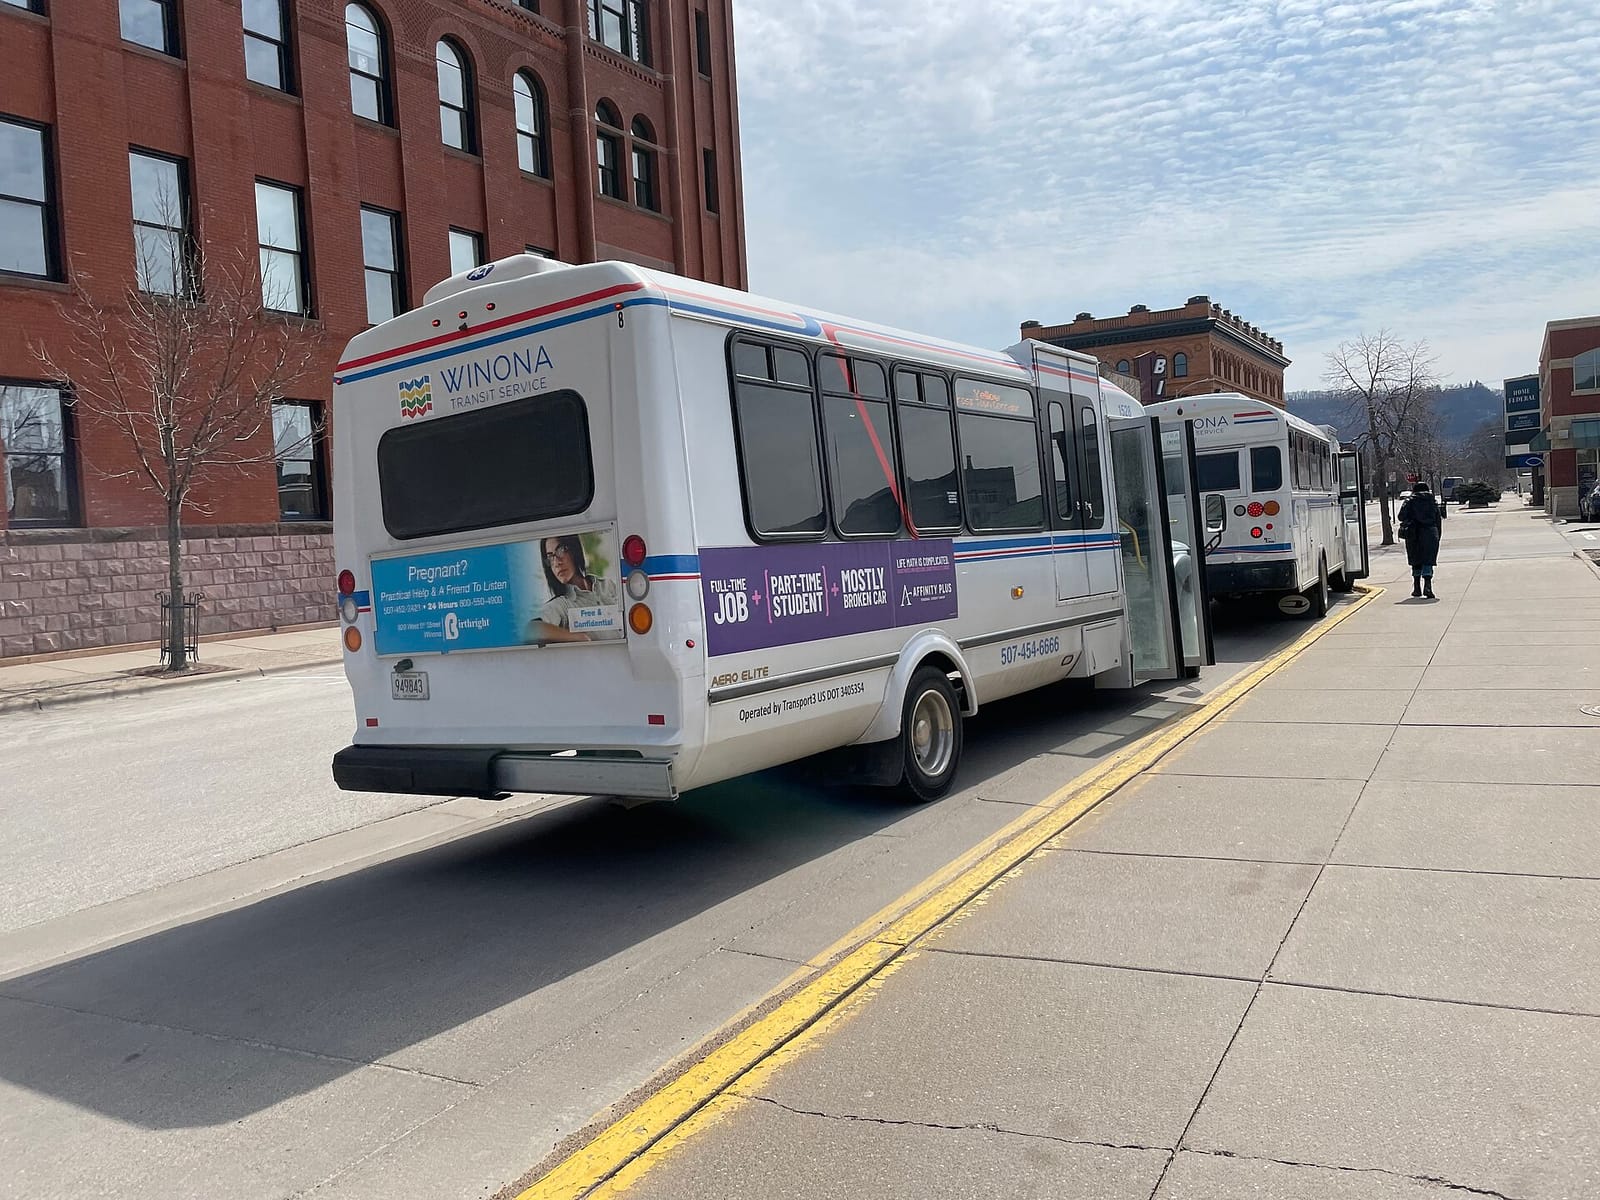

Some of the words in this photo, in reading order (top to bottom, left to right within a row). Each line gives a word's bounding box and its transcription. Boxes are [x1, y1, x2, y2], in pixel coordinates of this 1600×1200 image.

[618, 311, 624, 328] 8
[440, 345, 553, 393] WINONA
[450, 389, 495, 409] TRANSIT
[499, 377, 547, 398] SERVICE
[1508, 394, 1535, 404] FEDERAL
[1513, 388, 1530, 396] HOME
[1194, 415, 1229, 429] ONA
[408, 560, 468, 583] Pregnant?
[896, 559, 906, 569] LIFE
[906, 558, 918, 568] MATH
[918, 558, 922, 567] IS
[710, 578, 747, 593] FULL-TIME
[770, 573, 823, 595] PART-TIME
[841, 567, 884, 593] MOSTLY
[380, 590, 411, 601] Practical
[412, 588, 429, 599] Help
[431, 587, 437, 596] &
[438, 586, 444, 595] A
[446, 584, 470, 595] Friend
[473, 582, 481, 592] To
[484, 580, 507, 591] Listen
[843, 591, 872, 609] BROKEN
[873, 590, 887, 605] CAR
[913, 584, 937, 597] AFFINITY
[938, 583, 952, 594] PLUS
[438, 601, 458, 609] Hours
[580, 609, 596, 617] Free
[597, 608, 602, 616] &
[714, 591, 749, 625] JOB
[773, 592, 823, 617] STUDENT
[574, 618, 613, 628] Confidential
[1001, 636, 1060, 665] 507-454-6666
[395, 678, 423, 693] 949843
[711, 672, 738, 687] AERO
[741, 666, 769, 681] ELITE
[739, 705, 772, 723] Operated
[773, 703, 782, 715] by
[782, 693, 817, 711] Transport3
[817, 691, 826, 703] US
[827, 687, 840, 701] DOT
